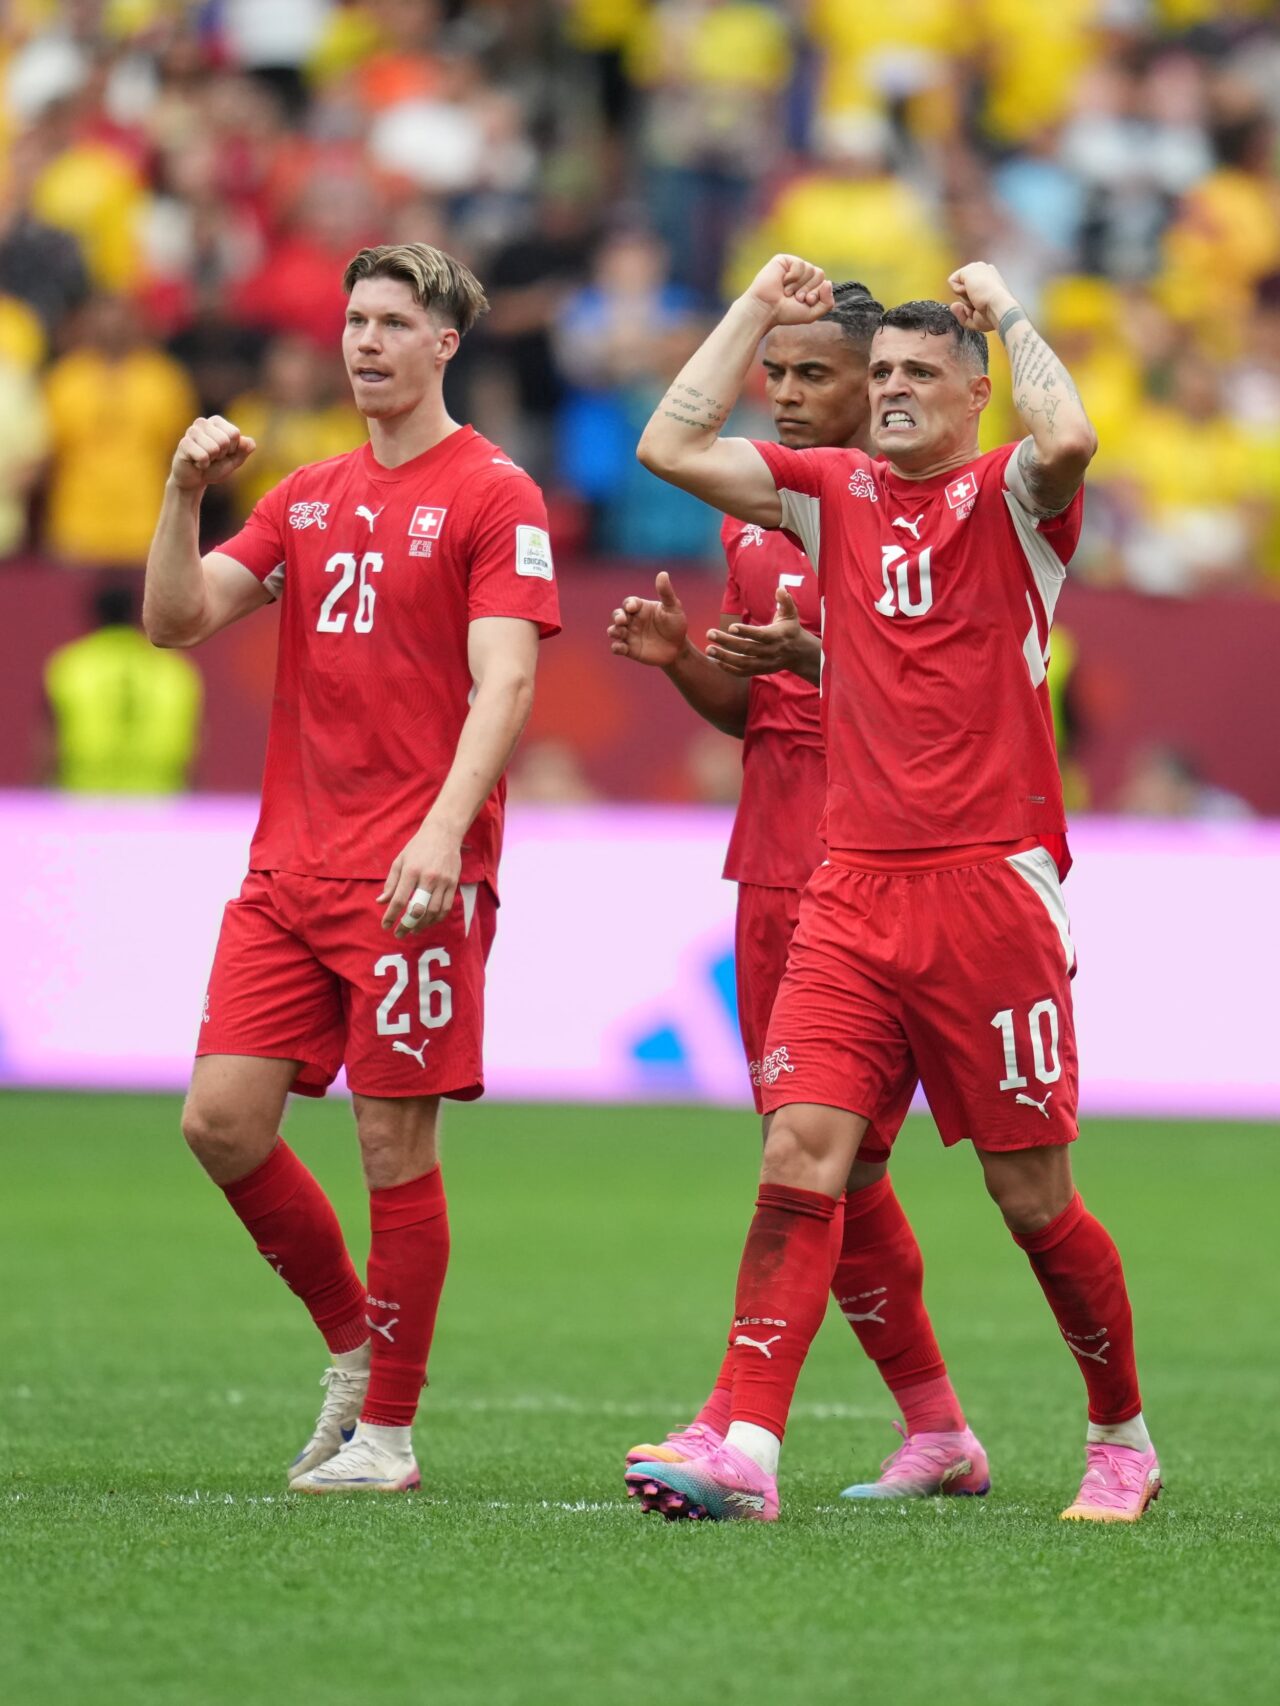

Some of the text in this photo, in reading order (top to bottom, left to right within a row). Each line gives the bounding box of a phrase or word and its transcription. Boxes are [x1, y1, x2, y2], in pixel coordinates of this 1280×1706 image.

[317, 551, 384, 633] 26
[874, 545, 933, 617] 10
[374, 947, 452, 1035] 26
[990, 998, 1061, 1091] 10
